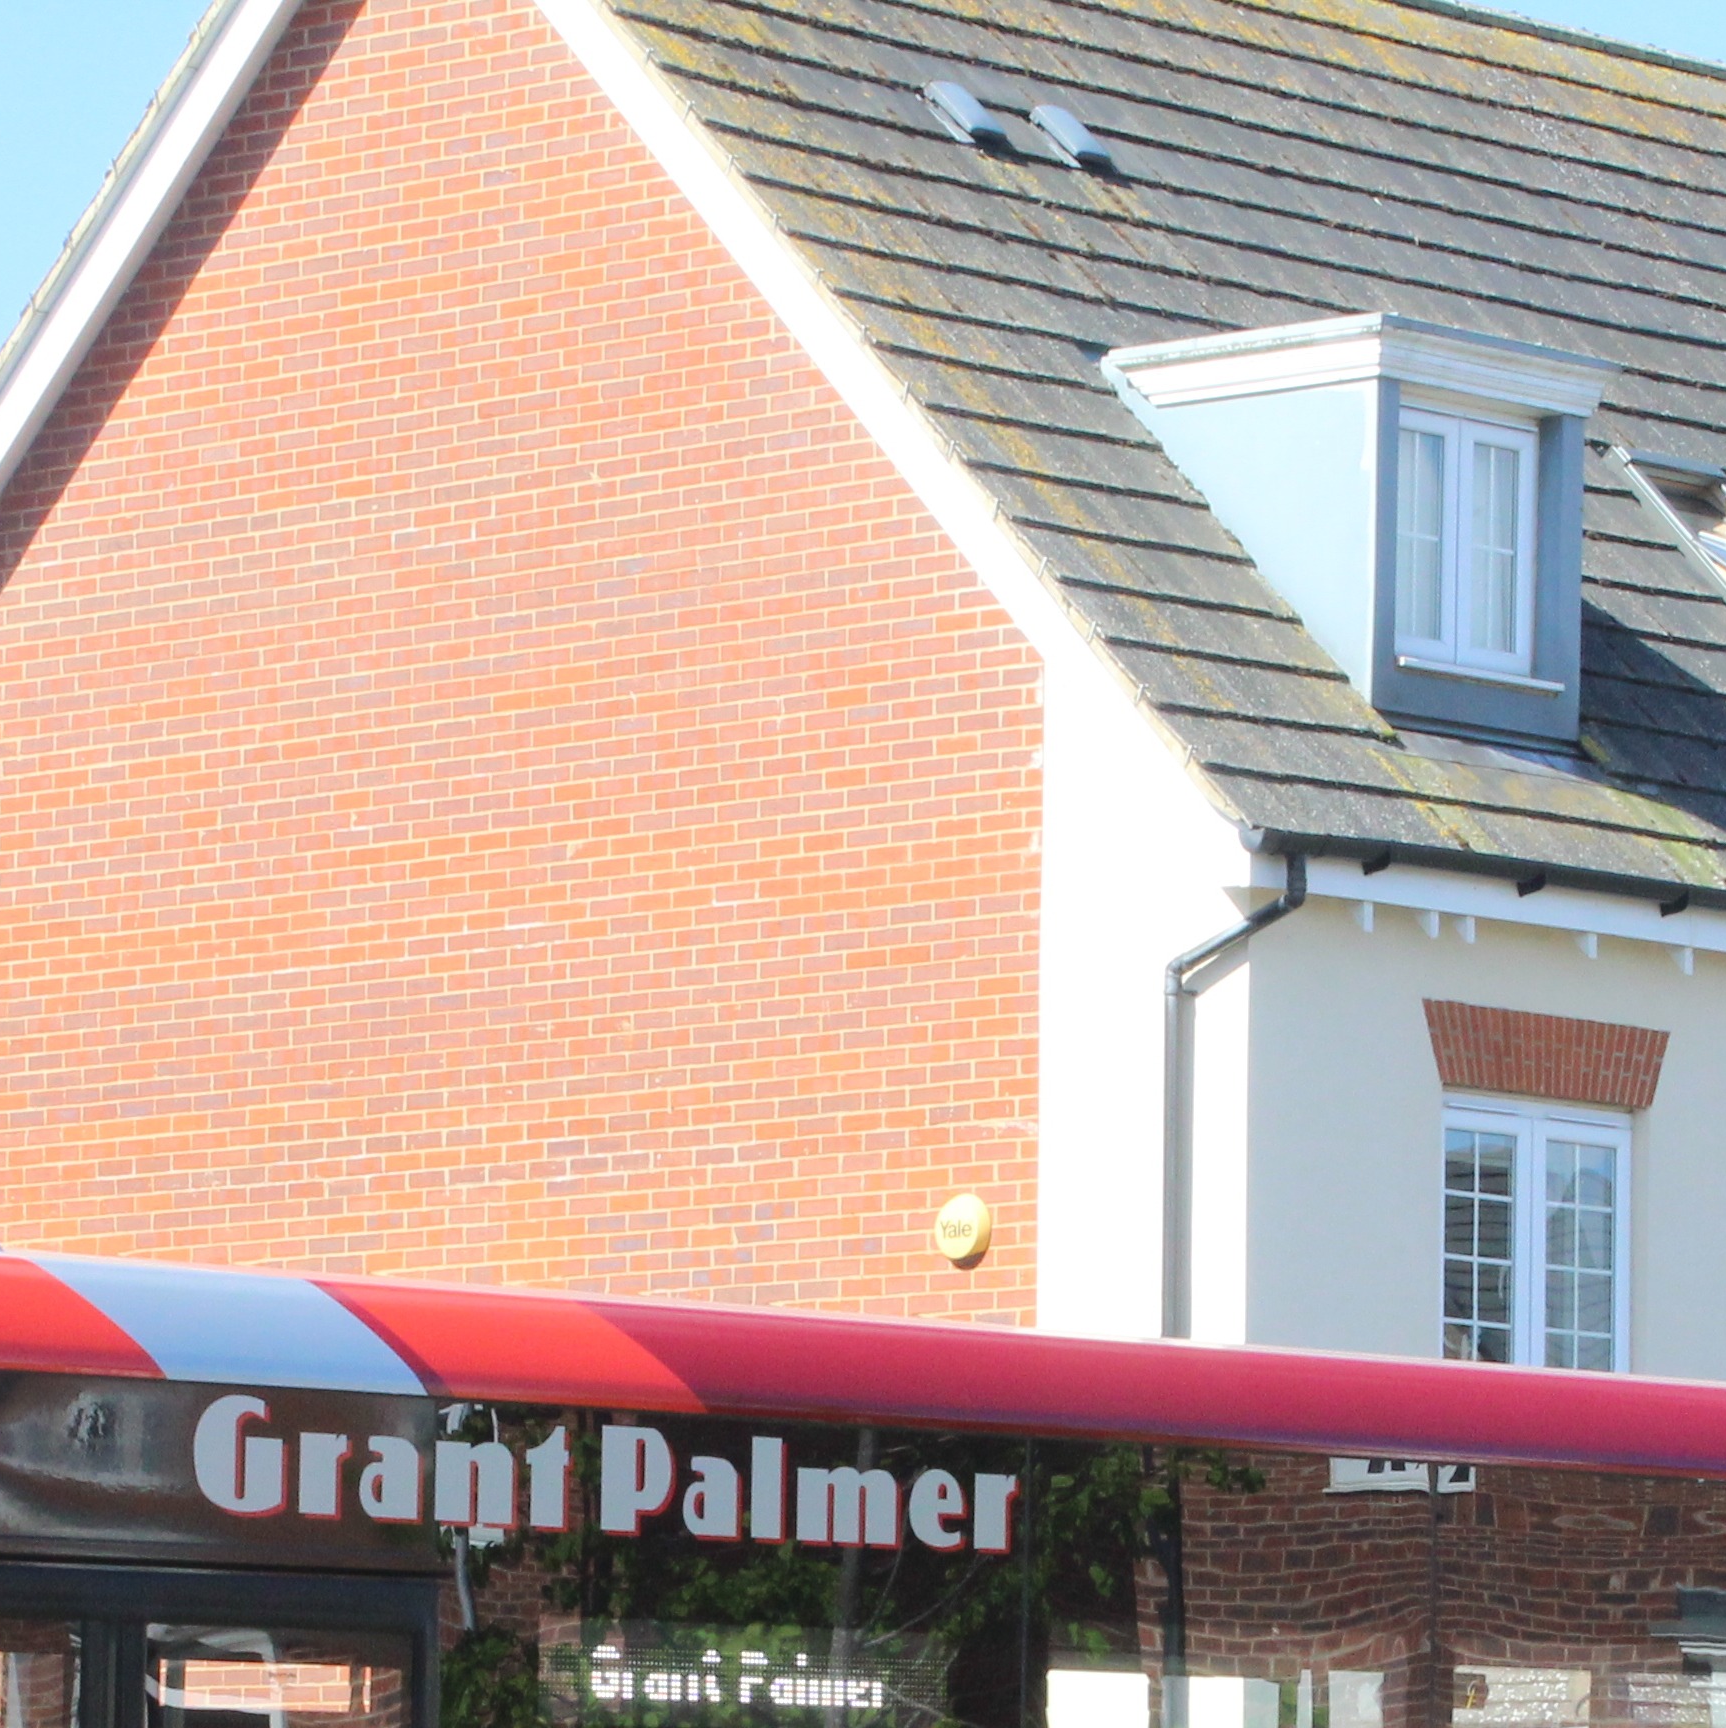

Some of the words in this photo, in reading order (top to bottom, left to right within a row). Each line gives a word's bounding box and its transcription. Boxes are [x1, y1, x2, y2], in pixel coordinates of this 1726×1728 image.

[940, 1220, 973, 1239] Yale
[192, 1394, 570, 1532] Grant
[600, 1424, 1017, 1554] Palmer
